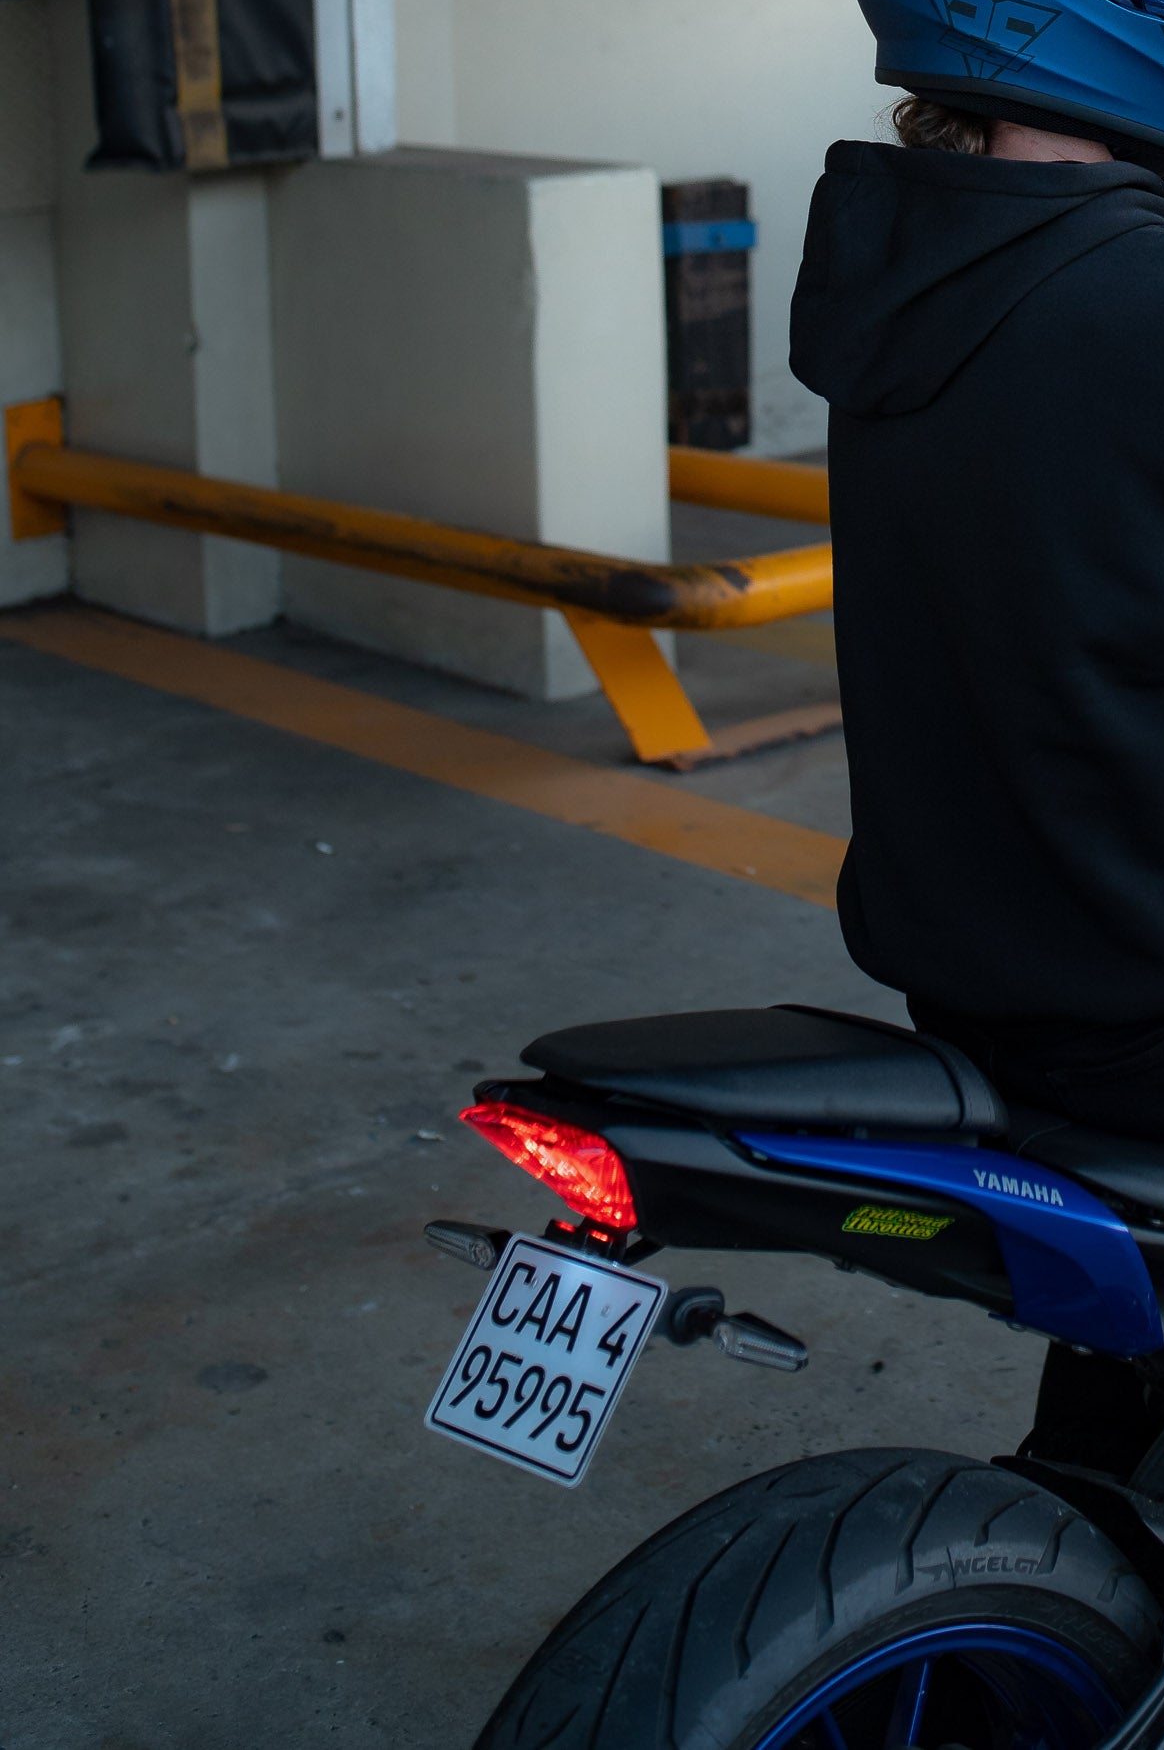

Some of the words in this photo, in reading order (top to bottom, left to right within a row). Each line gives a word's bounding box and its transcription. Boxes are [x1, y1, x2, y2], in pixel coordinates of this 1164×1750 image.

[973, 1168, 1064, 1207] YAMAHA
[491, 1261, 593, 1354] CAA
[597, 1301, 642, 1369] 4
[448, 1345, 607, 1452] 95995
